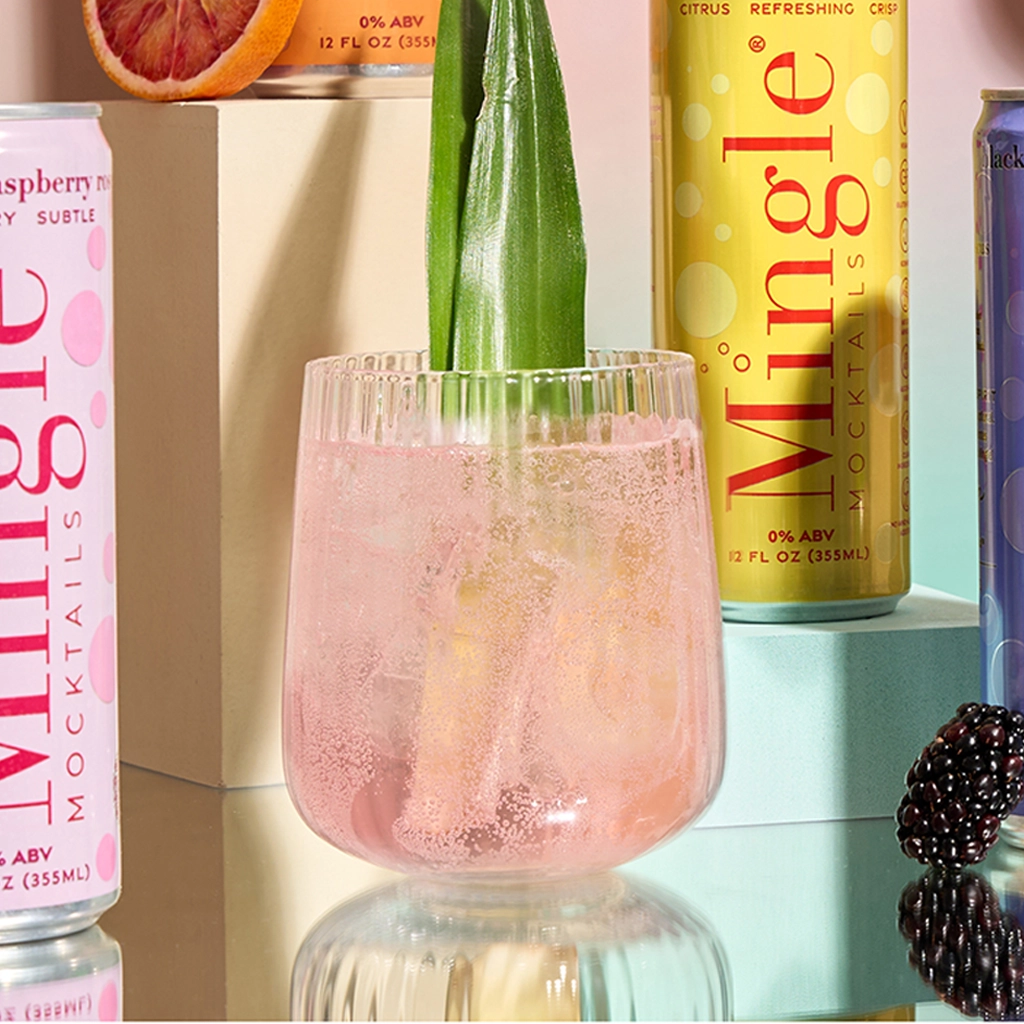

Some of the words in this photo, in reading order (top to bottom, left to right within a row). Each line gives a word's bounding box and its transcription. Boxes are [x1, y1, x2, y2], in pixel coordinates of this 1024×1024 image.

[679, 3, 731, 16] CITRUS
[750, 2, 855, 16] REFRESHING
[869, 2, 899, 16] CRISP
[359, 15, 386, 29] 0%
[389, 15, 424, 29] ABV
[319, 36, 334, 49] 12
[341, 36, 361, 49] FL
[368, 36, 392, 49] OZ
[37, 208, 95, 225] SUBTLE
[847, 253, 866, 511] MOCKTAILS
[767, 529, 795, 543] 0%
[798, 528, 835, 542] ABV
[729, 550, 742, 563] 12
[749, 551, 769, 563] FL
[776, 550, 800, 563] OZ
[808, 545, 870, 564] (355ML)
[63, 509, 86, 824] MOCKTAILS
[11, 845, 53, 866] ABV
[23, 863, 91, 890] (355ML)
